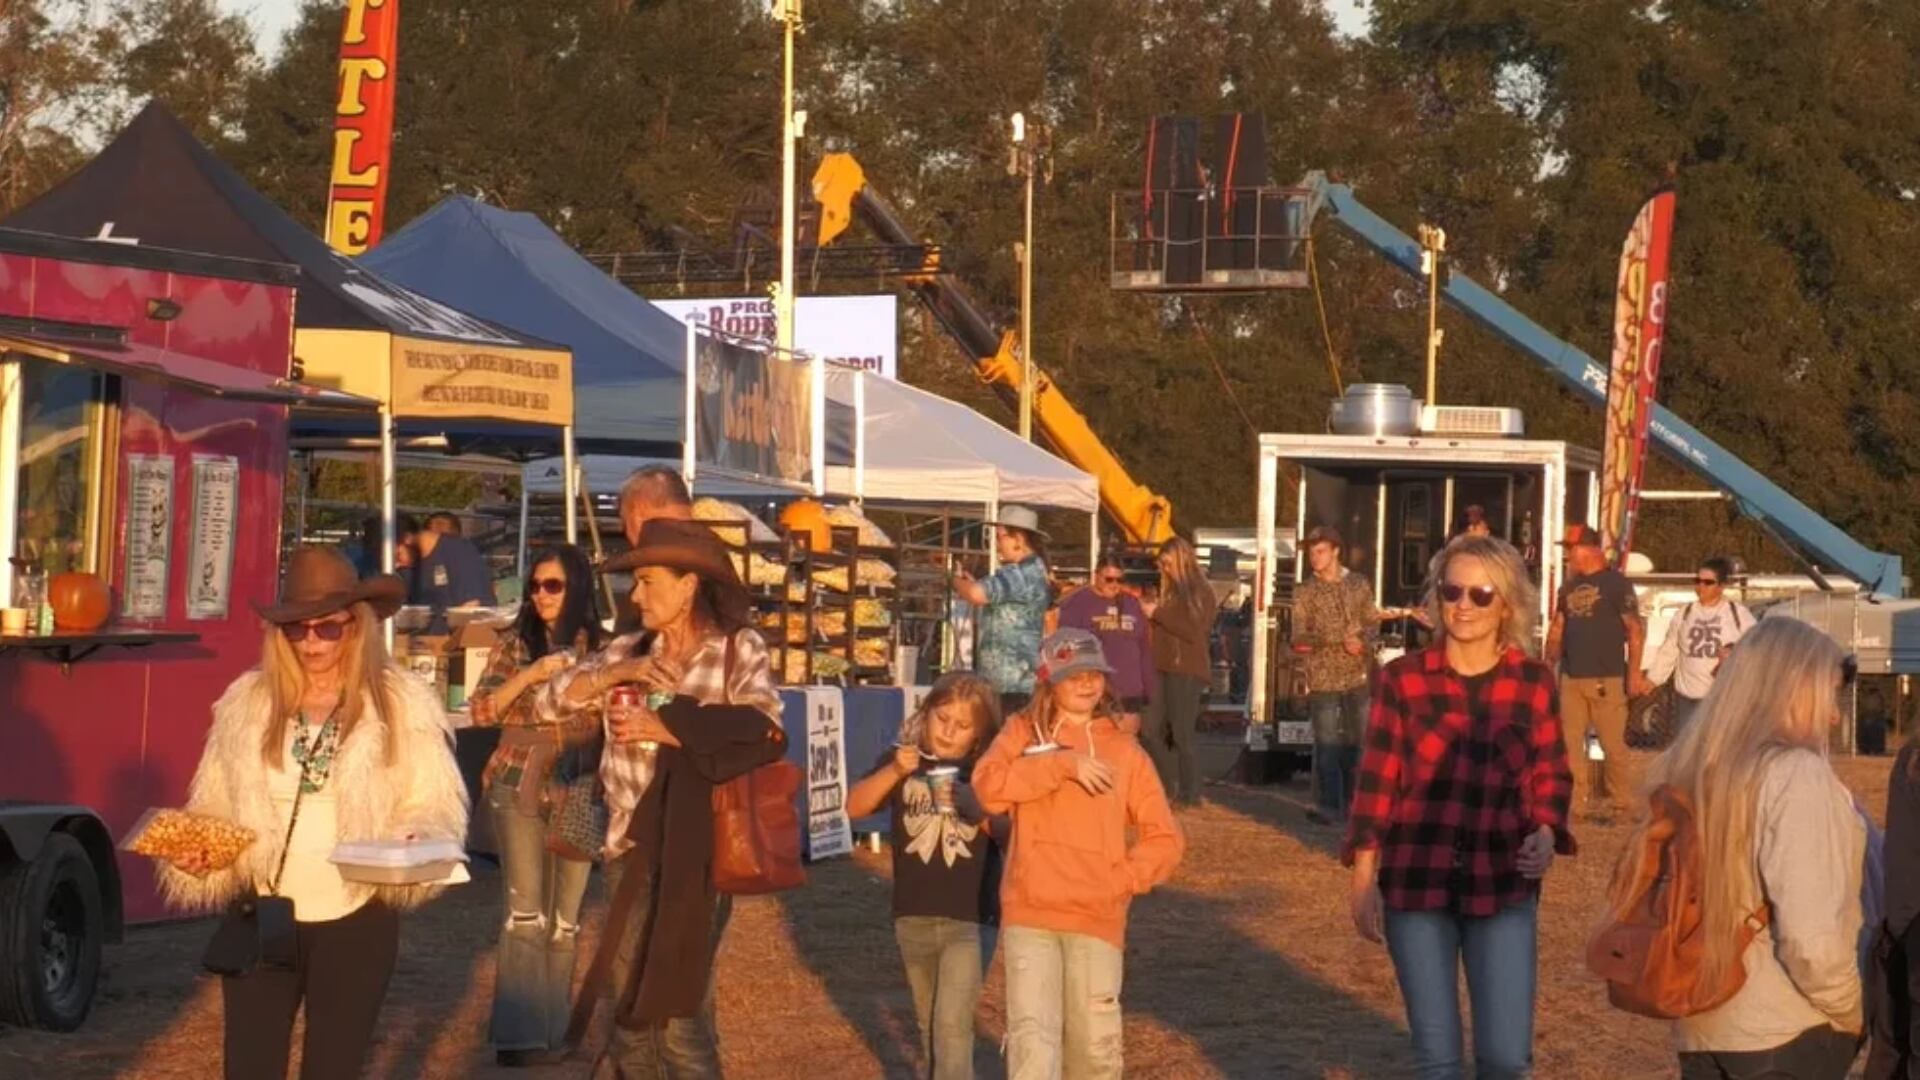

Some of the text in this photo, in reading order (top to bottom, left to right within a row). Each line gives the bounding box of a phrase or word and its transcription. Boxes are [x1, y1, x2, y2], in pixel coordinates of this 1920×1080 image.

[709, 306, 776, 338] RODE
[731, 302, 776, 314] PRO
[1688, 626, 1721, 658] 25
